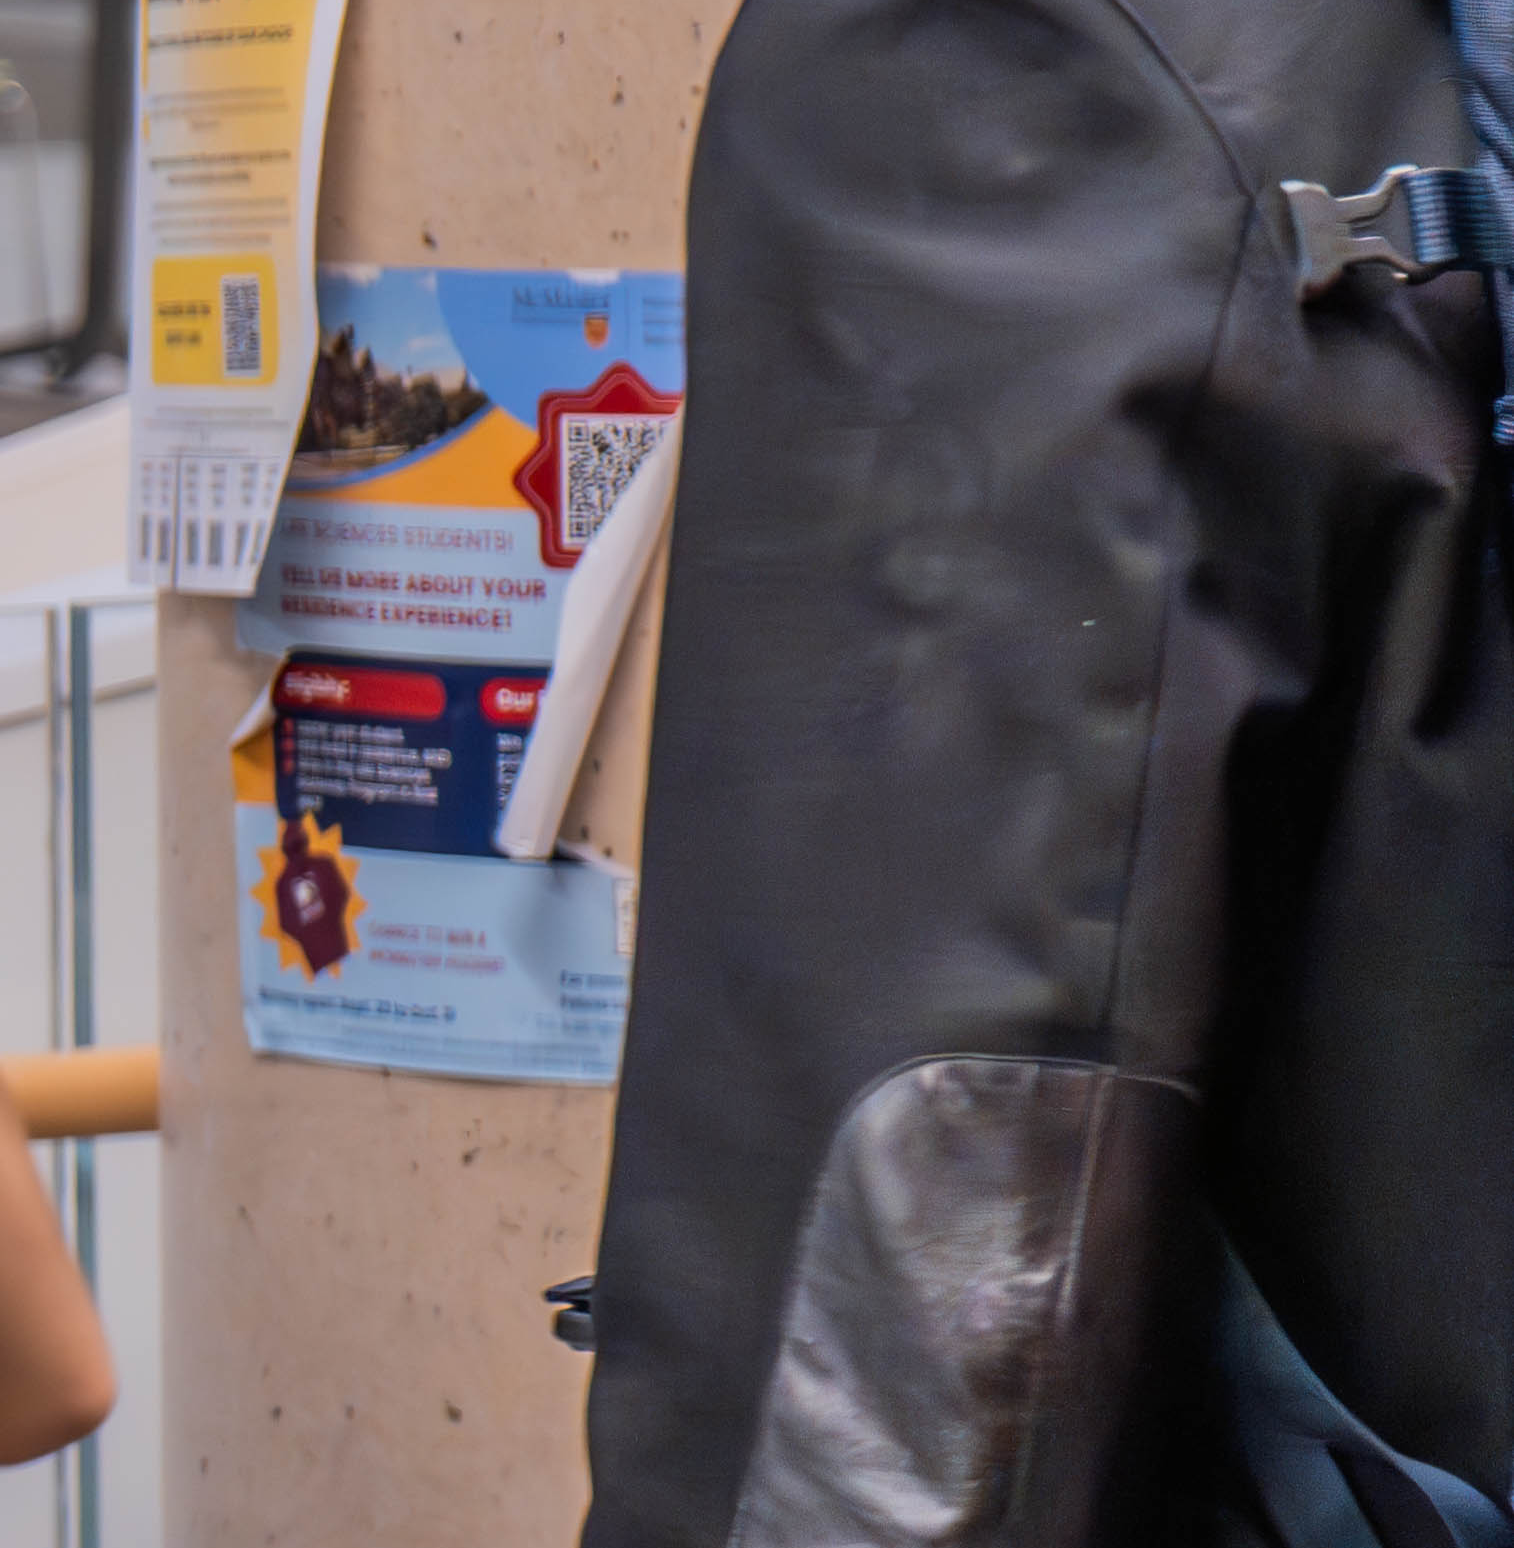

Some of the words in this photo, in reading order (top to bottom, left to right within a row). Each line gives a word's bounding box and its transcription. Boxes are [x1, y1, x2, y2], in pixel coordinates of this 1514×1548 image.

[345, 570, 401, 591] MORE
[405, 572, 475, 597] ABOUT
[480, 577, 548, 601] YOUR
